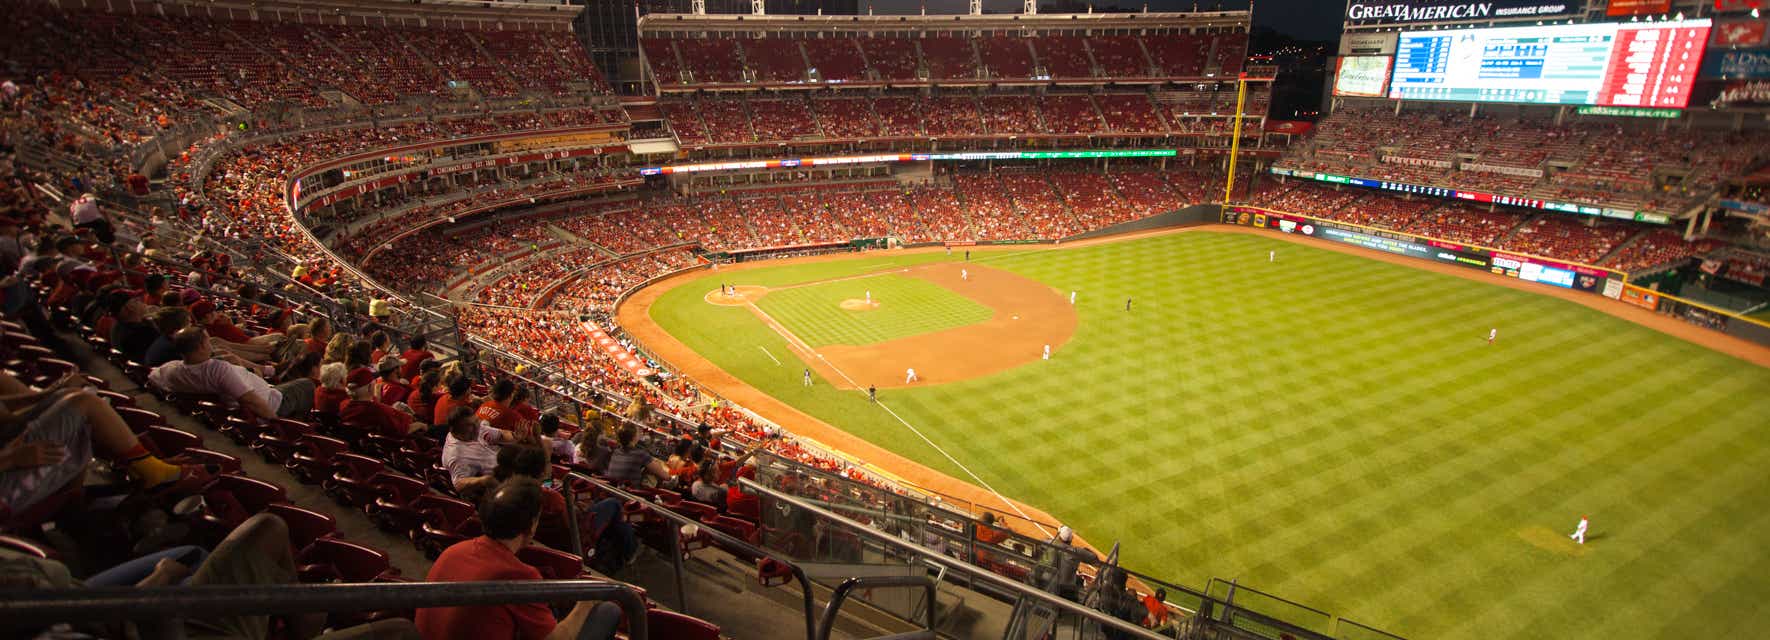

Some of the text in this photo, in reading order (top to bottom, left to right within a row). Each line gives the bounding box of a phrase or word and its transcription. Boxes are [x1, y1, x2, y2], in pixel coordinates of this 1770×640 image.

[1349, 3, 1566, 21] GREAT AMERICAN INSURANCE GROUP
